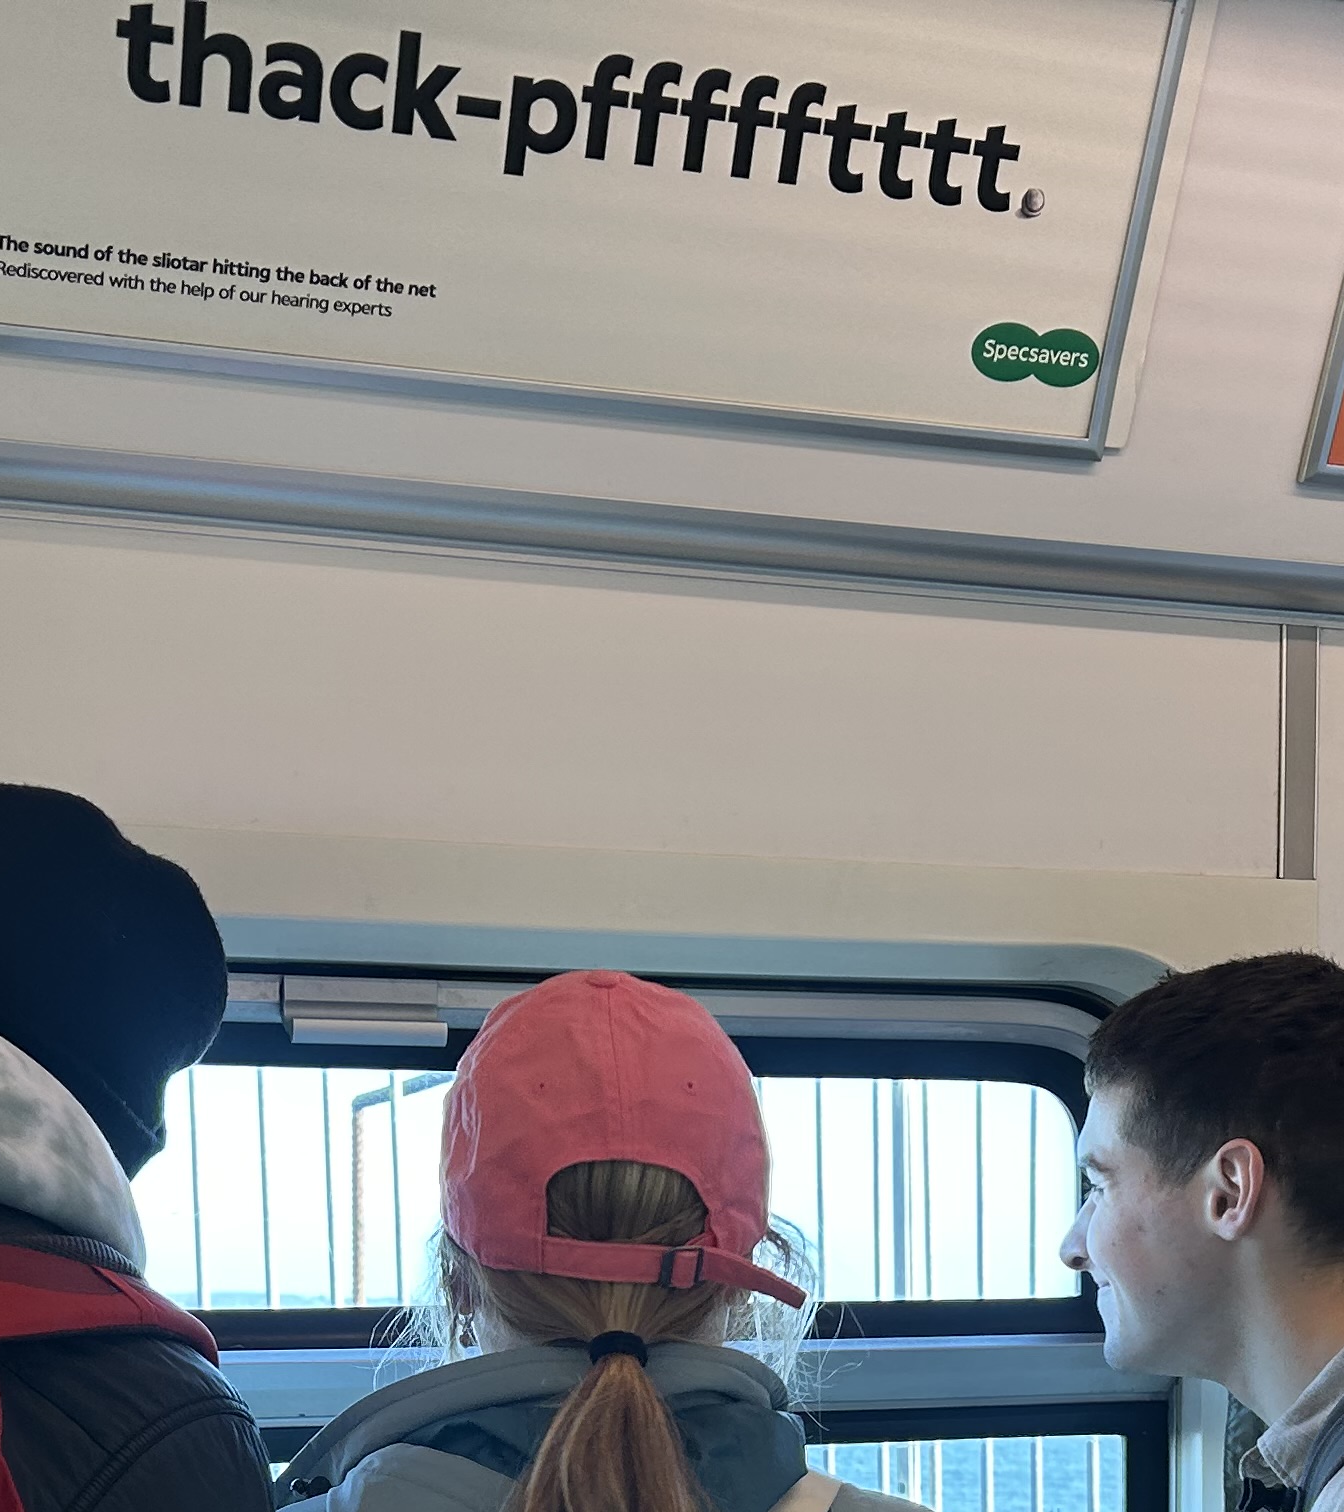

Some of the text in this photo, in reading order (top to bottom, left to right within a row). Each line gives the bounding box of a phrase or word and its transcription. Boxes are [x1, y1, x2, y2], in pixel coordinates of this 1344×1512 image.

[33, 241, 90, 259] sound
[93, 245, 114, 262] of
[117, 248, 149, 266] the
[152, 252, 208, 273] sliotar
[212, 258, 271, 283] hitting
[275, 266, 305, 284] the
[309, 269, 349, 289] back
[353, 274, 373, 291] of
[375, 276, 405, 295] the
[407, 283, 438, 299] net
[108, 273, 145, 292] with
[149, 276, 177, 295] the
[180, 279, 215, 301] help
[218, 284, 237, 301] of
[239, 289, 268, 304] our
[271, 289, 329, 314] hearing
[333, 300, 393, 318] experts
[982, 338, 1090, 369] Specsavers
